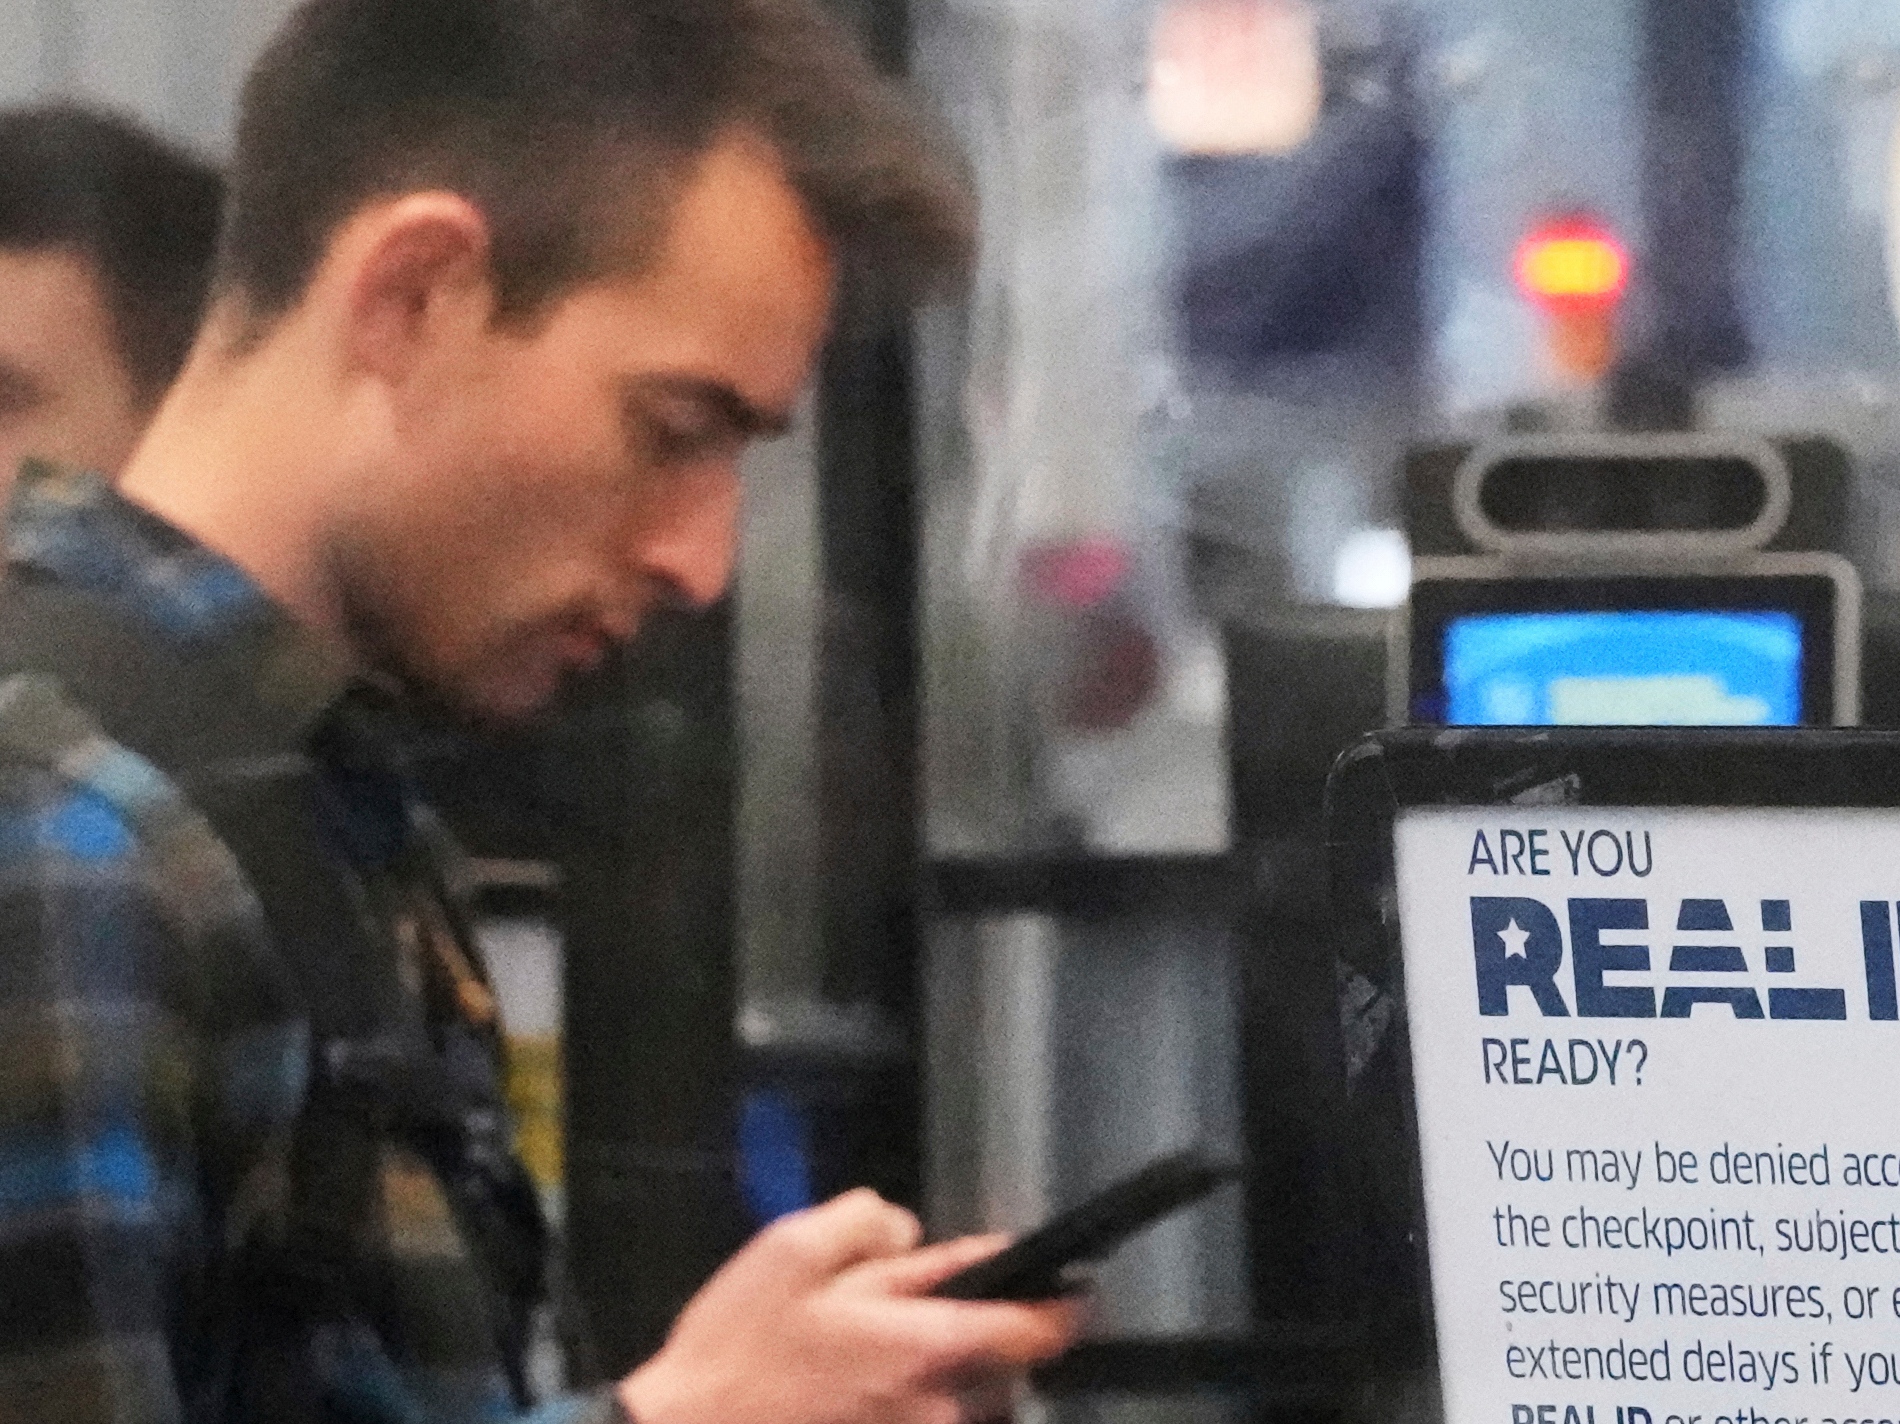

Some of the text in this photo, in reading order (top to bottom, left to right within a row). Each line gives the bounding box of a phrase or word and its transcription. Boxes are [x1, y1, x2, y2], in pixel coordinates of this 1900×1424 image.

[1468, 829, 1652, 877] ARE YOU
[1470, 896, 1847, 1020] REAL
[1482, 1038, 1648, 1085] READY?
[1486, 1141, 1553, 1182] You
[1566, 1149, 1642, 1190] may
[1655, 1141, 1698, 1184] be
[1710, 1142, 1830, 1186] denied
[1493, 1204, 1550, 1247] the
[1562, 1206, 1764, 1257] checkpoint,
[1500, 1273, 1641, 1321] security
[1654, 1283, 1832, 1324] measures,
[1844, 1286, 1879, 1319] or
[1506, 1338, 1671, 1381] extended
[1683, 1340, 1798, 1390] delays
[1810, 1342, 1832, 1384] if
